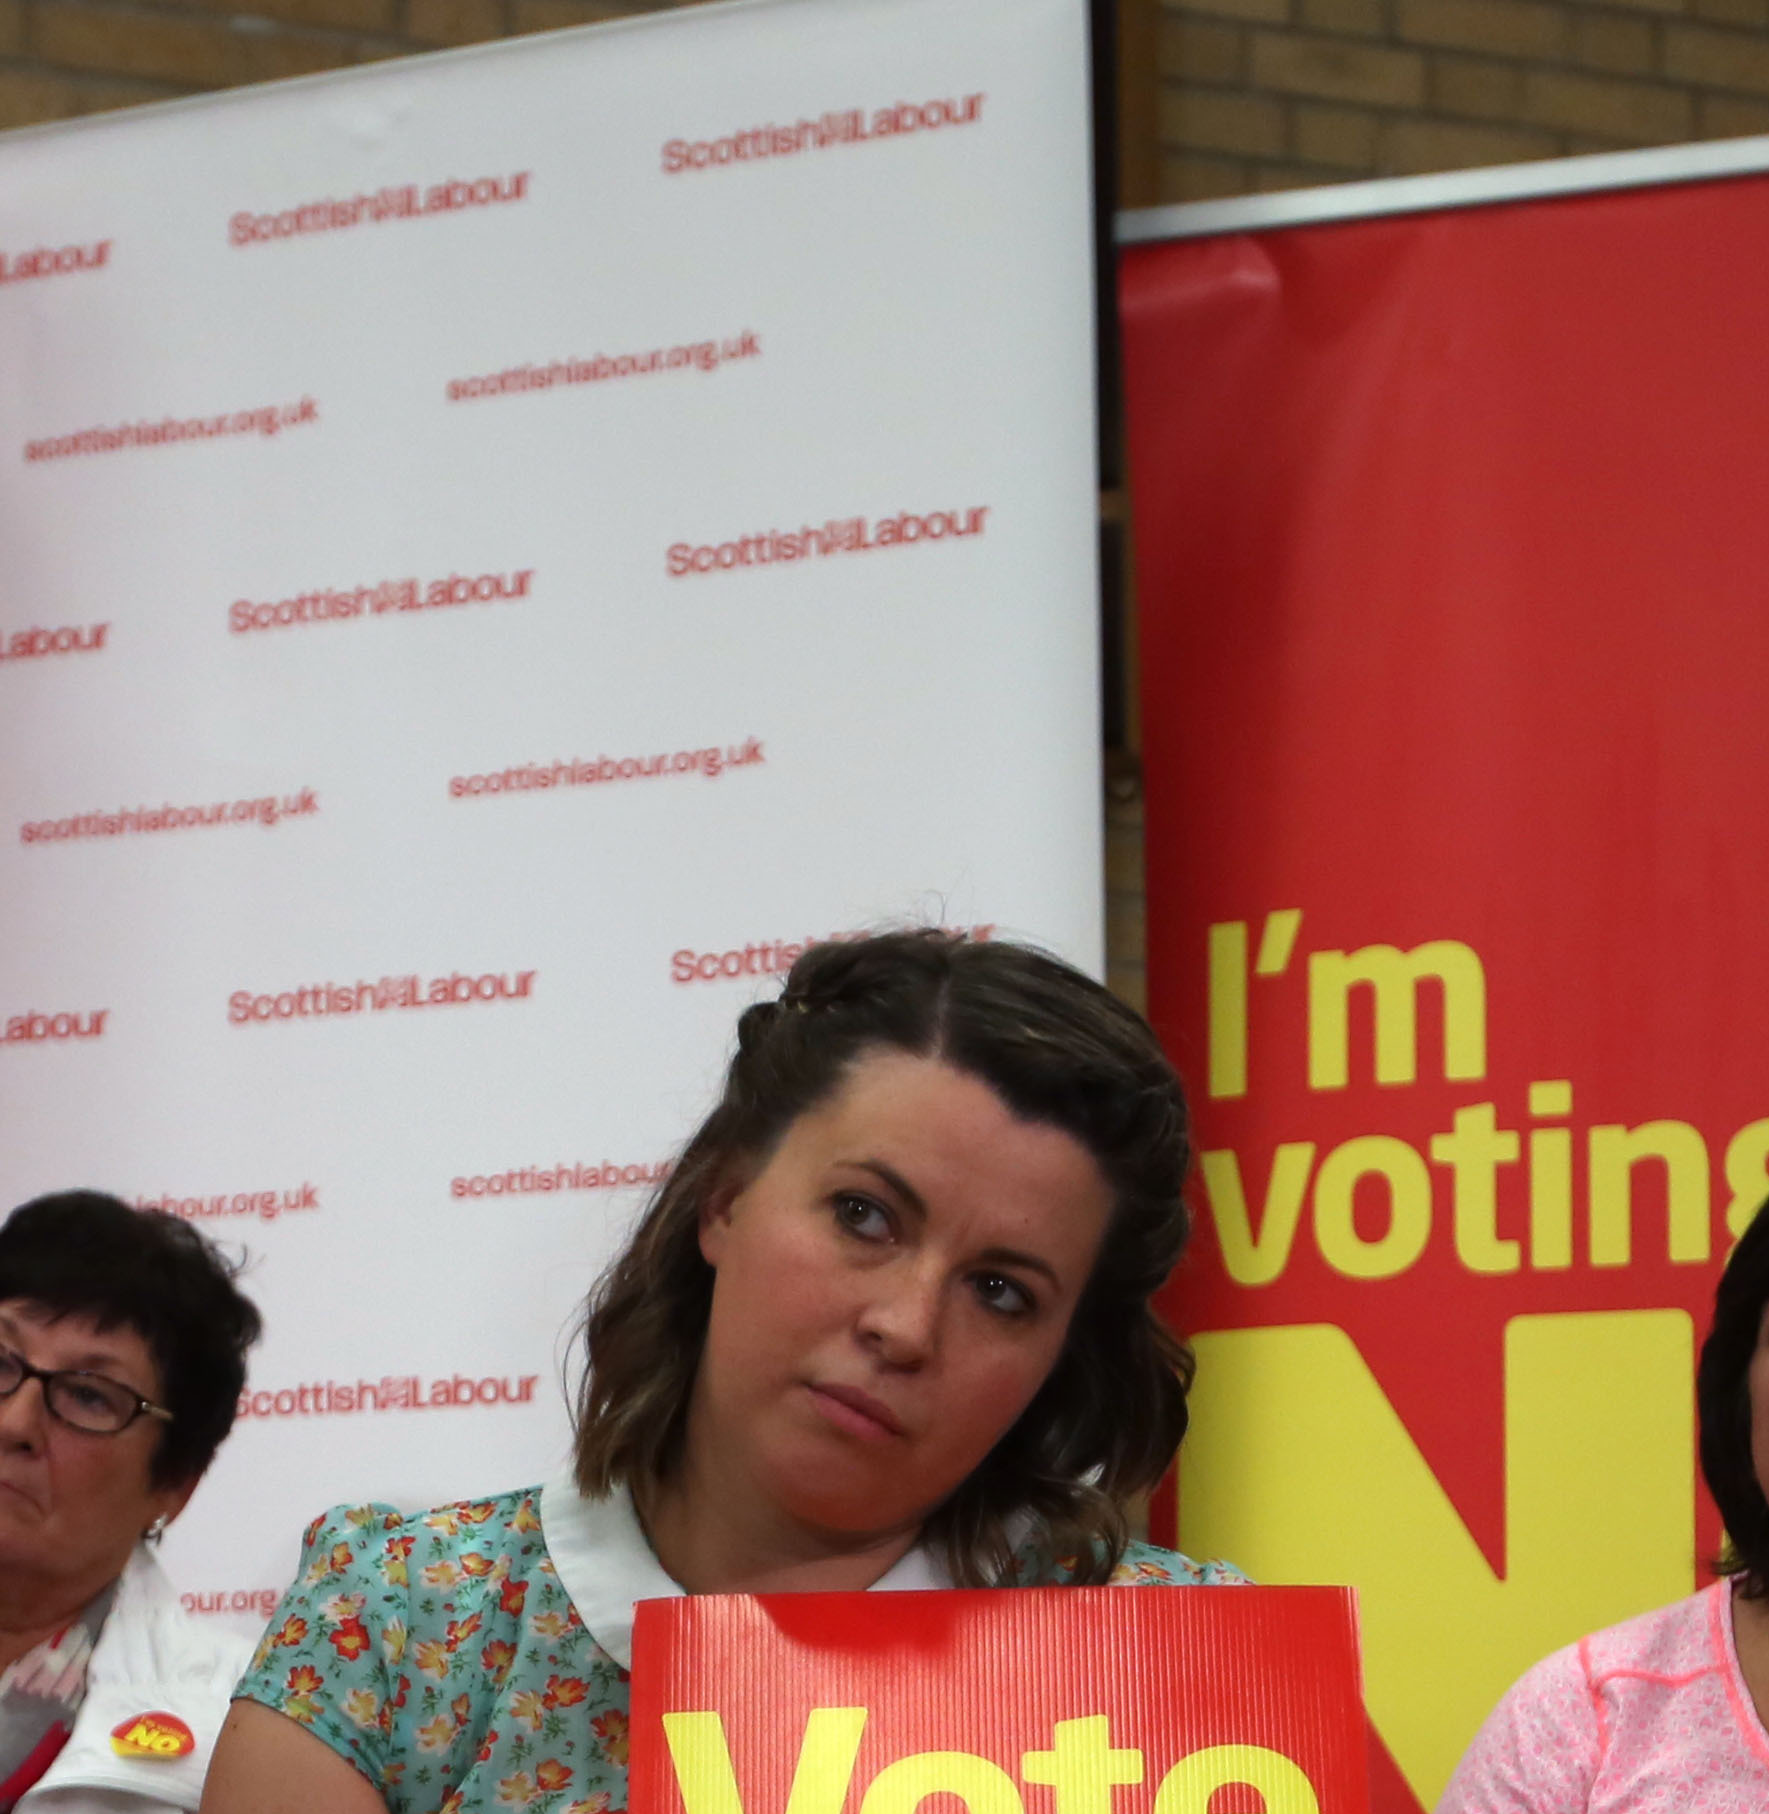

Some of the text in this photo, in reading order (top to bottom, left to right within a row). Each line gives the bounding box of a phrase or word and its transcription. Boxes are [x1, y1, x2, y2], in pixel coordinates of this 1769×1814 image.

[447, 332, 760, 401] scottishlabour.org.uk
[449, 737, 765, 799] scottishlabour.org.uk
[22, 787, 318, 843] scottishlabour.org.uk
[1208, 909, 1486, 1099] I'm
[124, 1723, 181, 1752] NO
